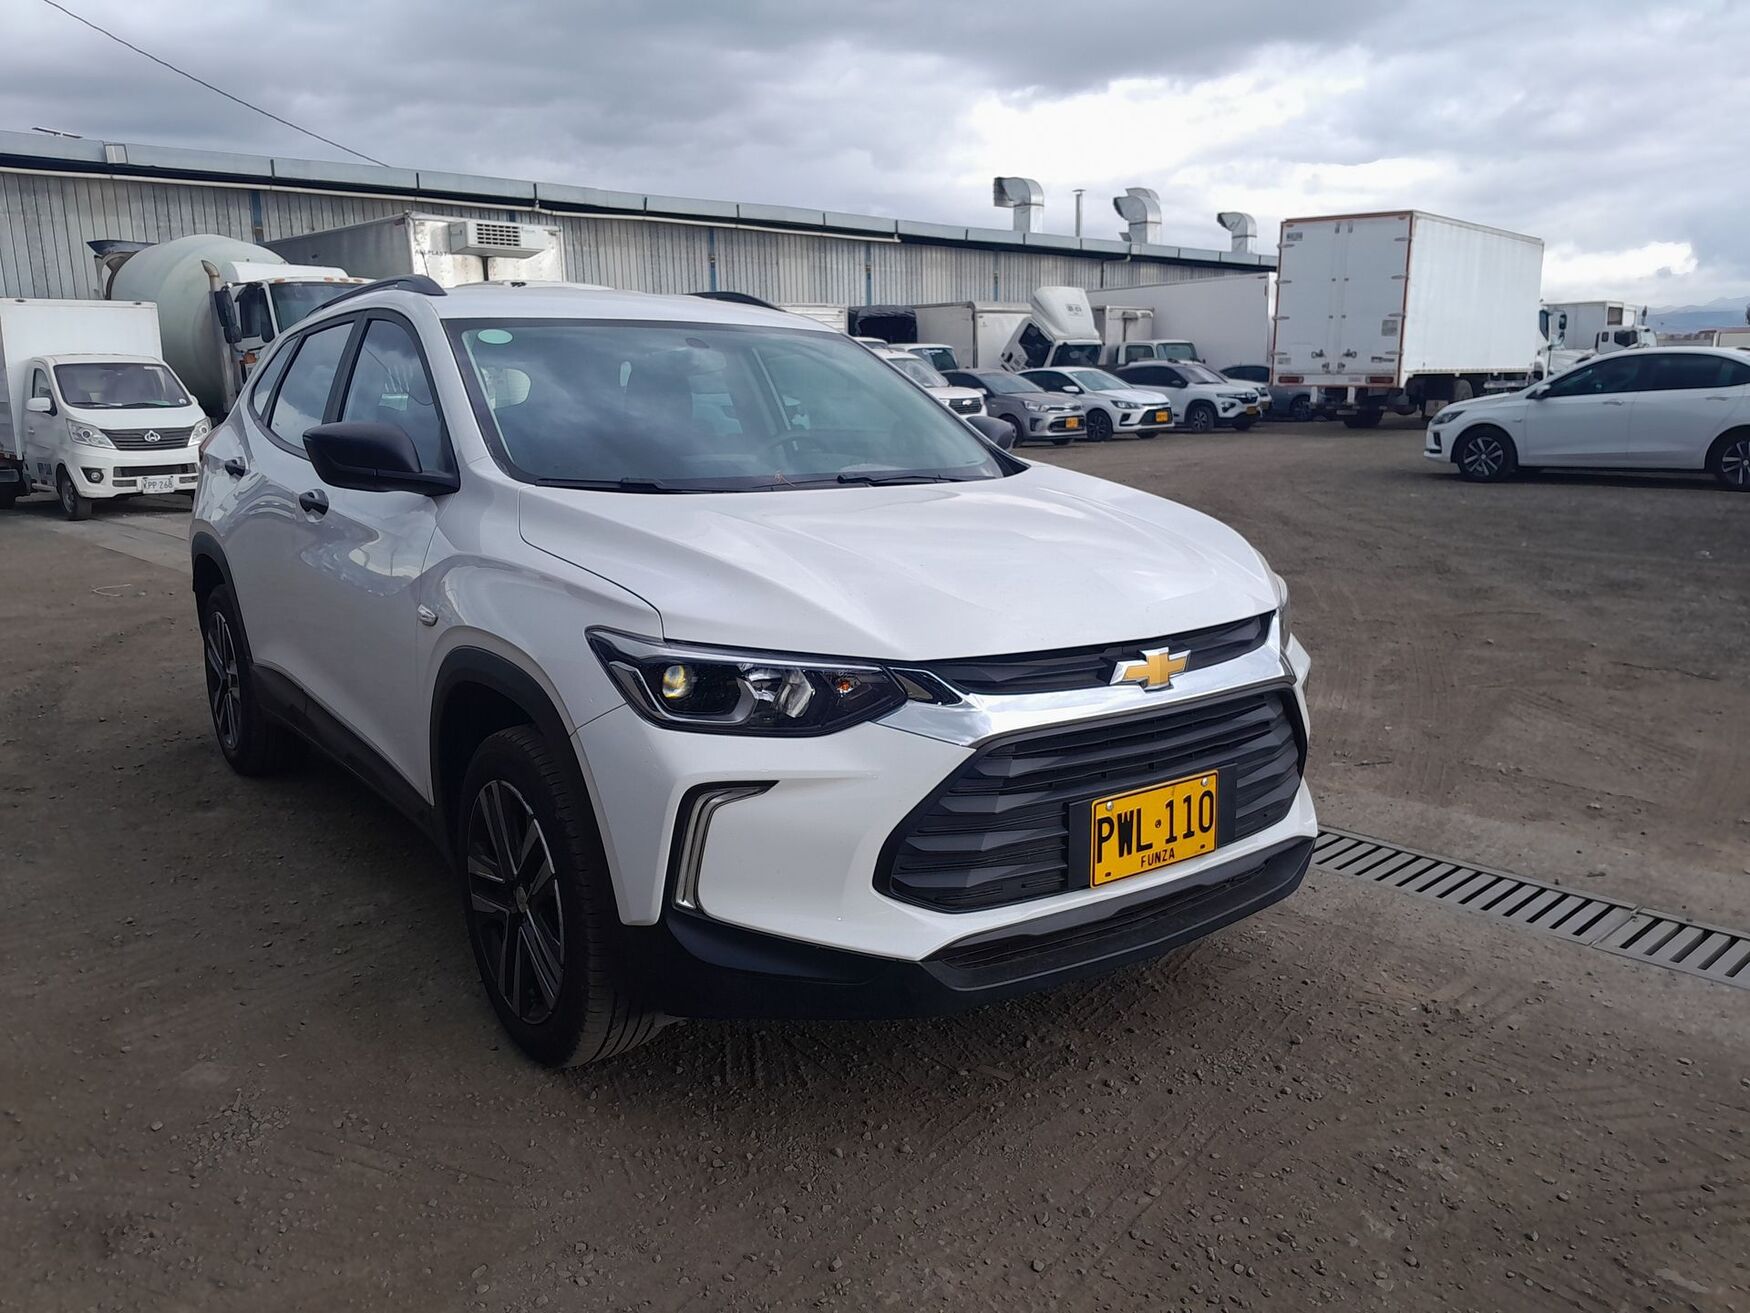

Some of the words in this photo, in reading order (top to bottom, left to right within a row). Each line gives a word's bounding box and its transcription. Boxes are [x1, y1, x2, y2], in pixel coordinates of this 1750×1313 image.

[1096, 808, 1153, 864] PWL
[1165, 789, 1215, 845] 110
[1140, 847, 1176, 868] FUNZA
